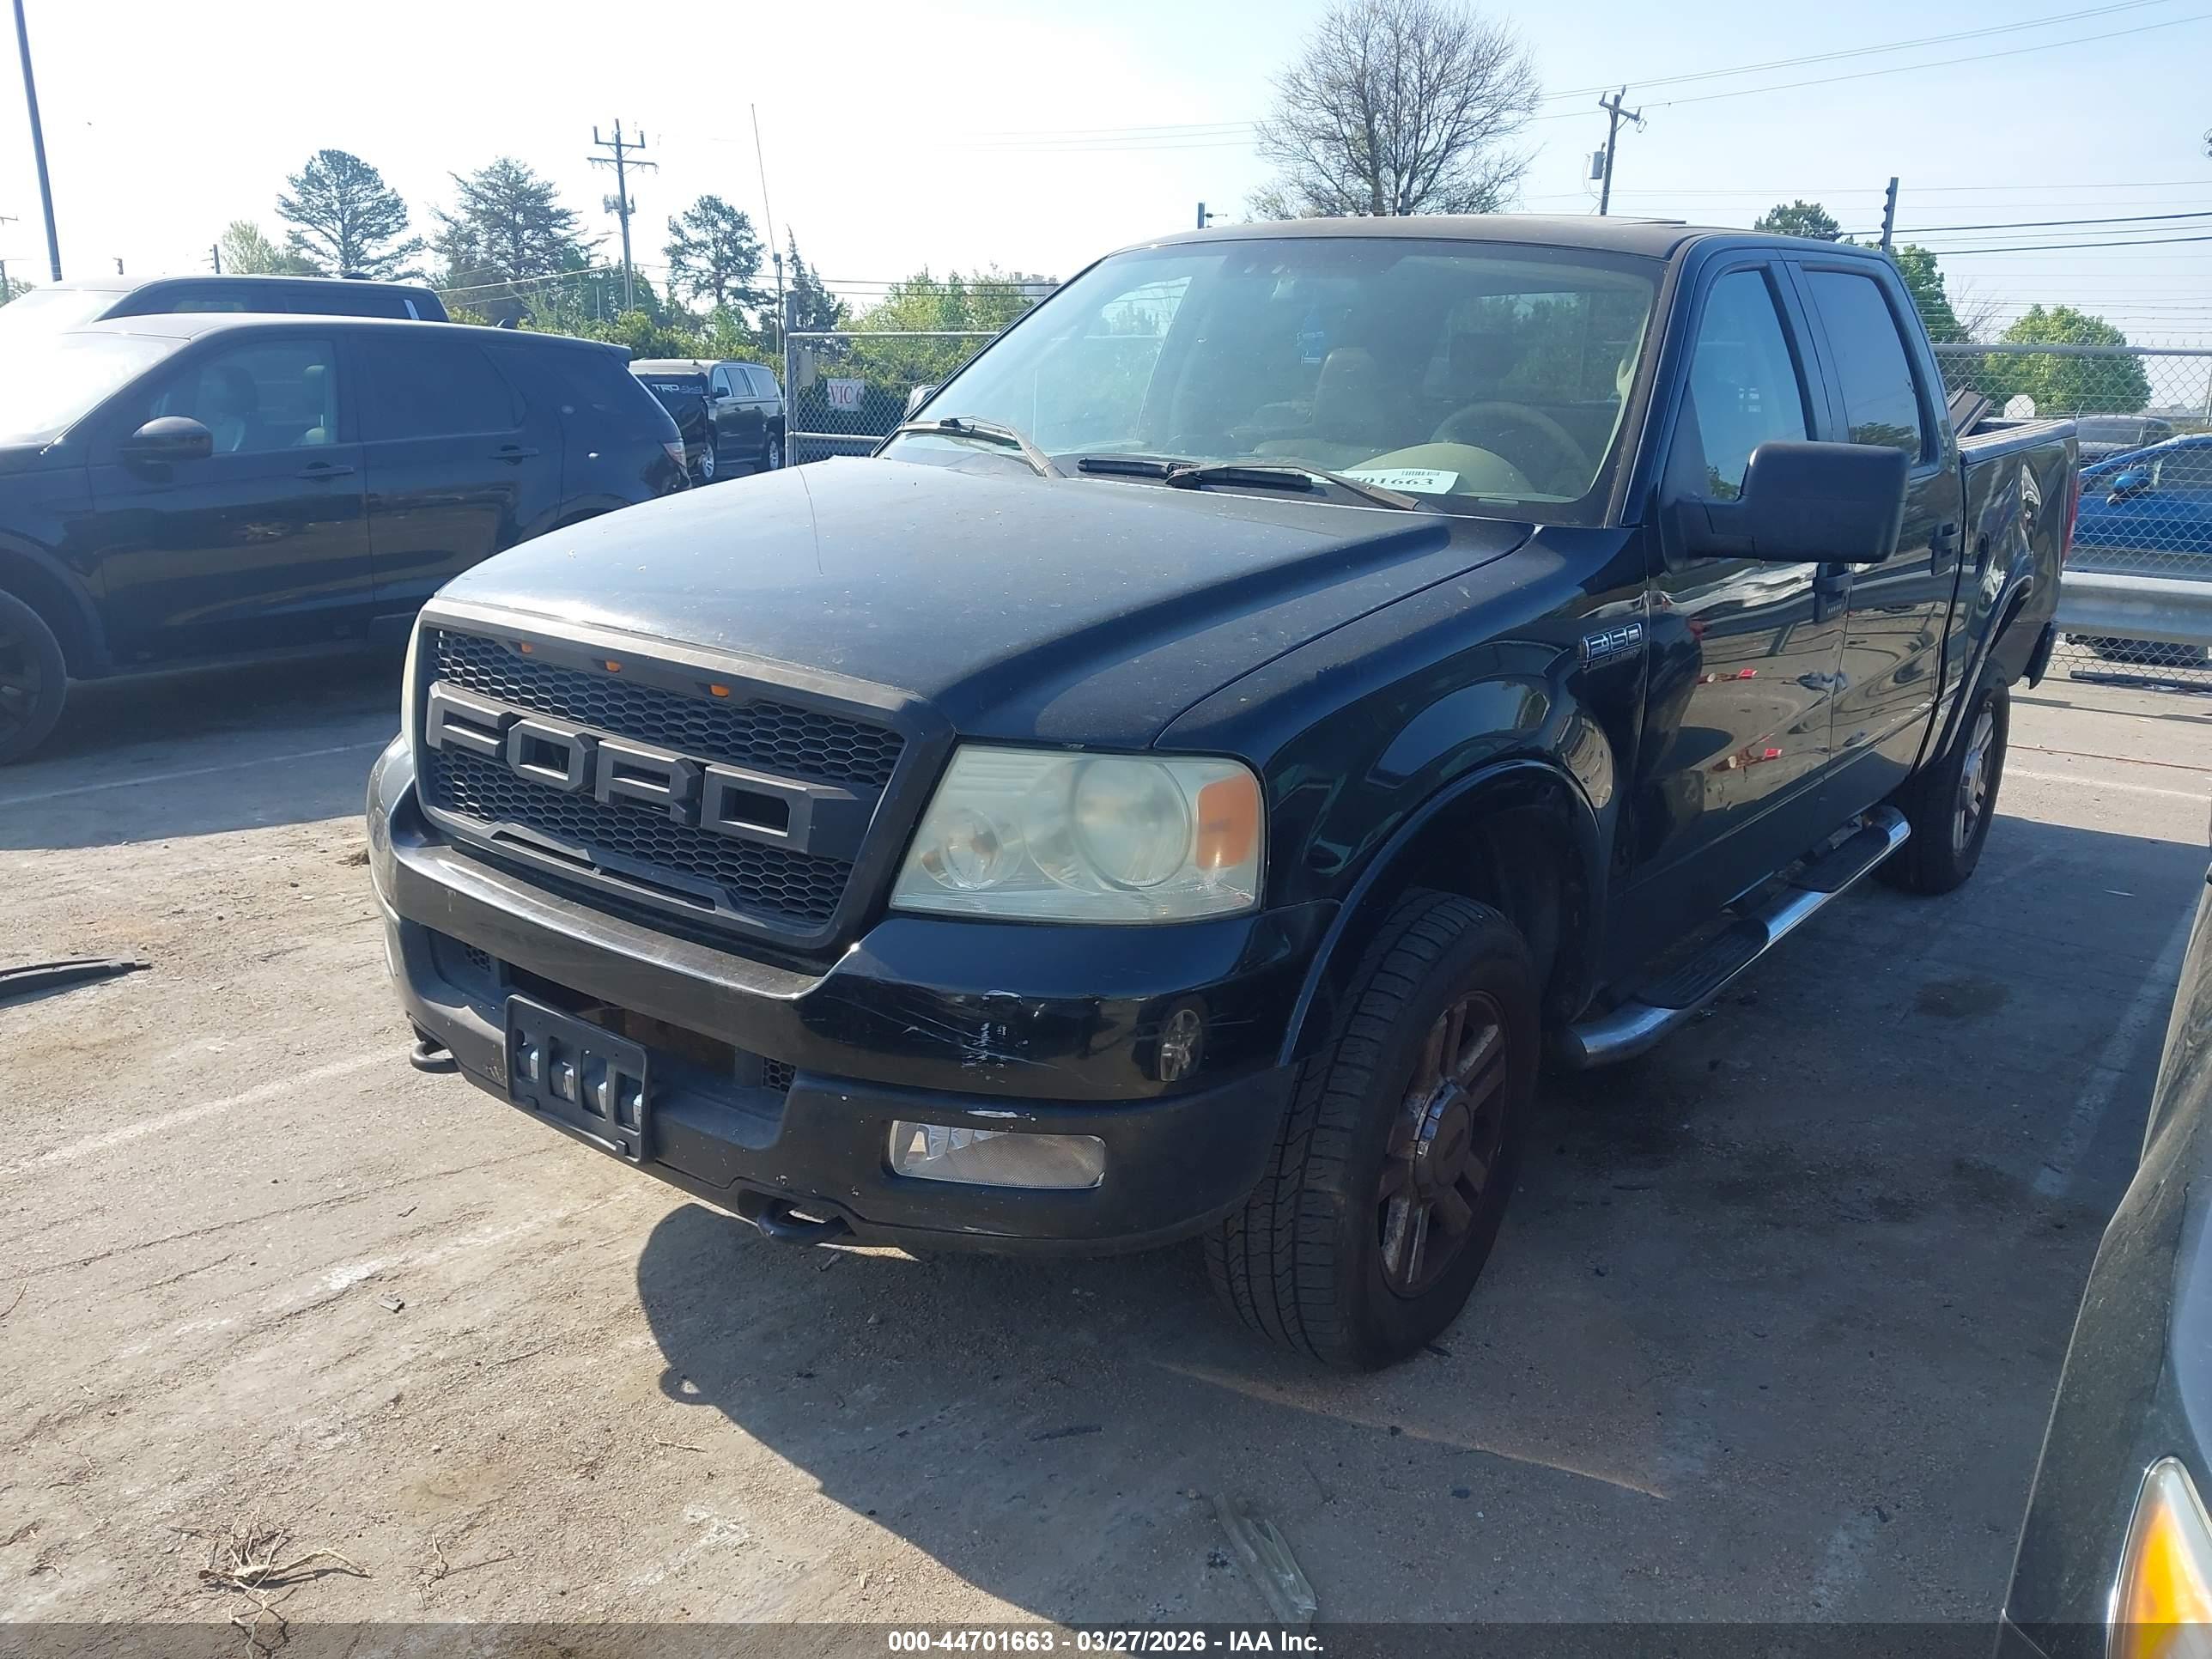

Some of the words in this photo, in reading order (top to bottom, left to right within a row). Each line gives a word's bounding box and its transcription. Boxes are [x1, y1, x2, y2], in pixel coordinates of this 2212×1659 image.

[651, 383, 680, 392] TRD
[830, 386, 853, 404] VIC
[426, 680, 850, 854] FORD
